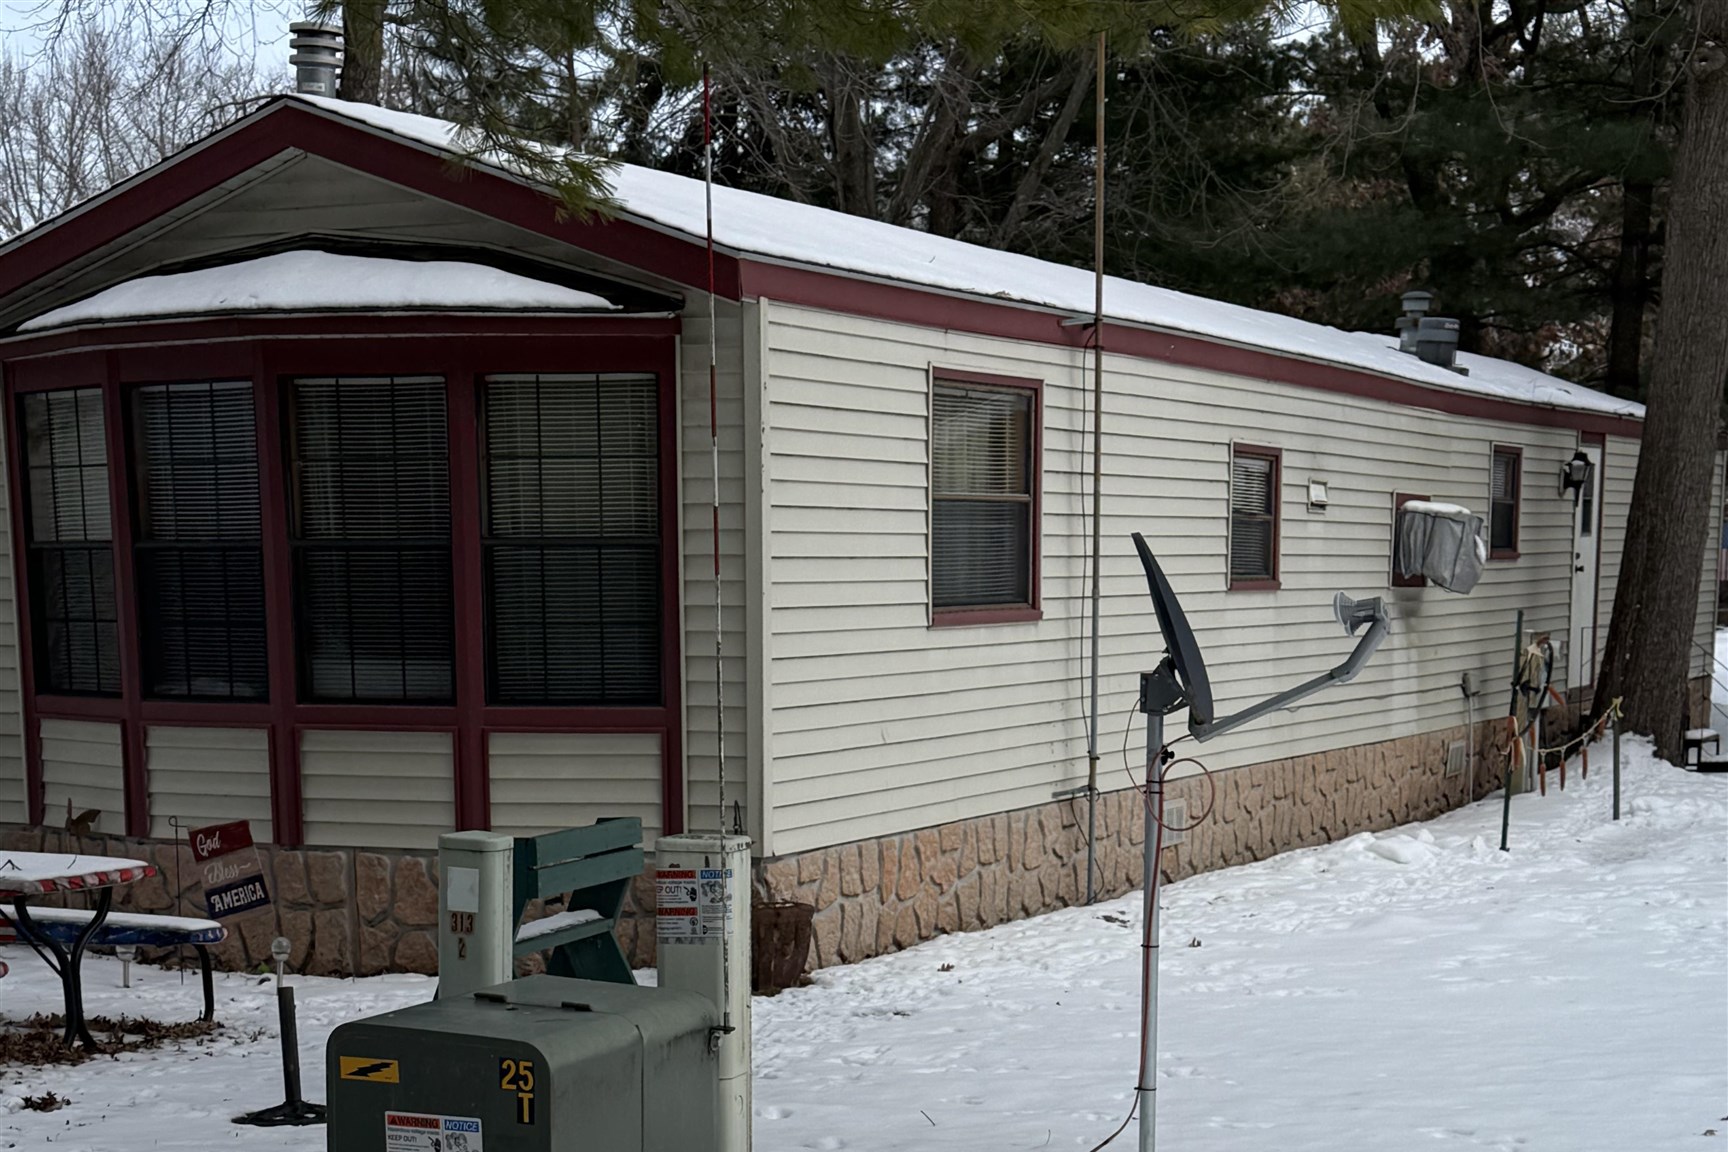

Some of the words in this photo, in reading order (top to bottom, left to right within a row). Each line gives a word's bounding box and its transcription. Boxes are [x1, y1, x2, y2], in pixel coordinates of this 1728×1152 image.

[196, 831, 221, 857] God
[204, 862, 251, 884] Bless
[210, 882, 264, 912] AMERICA
[665, 886, 682, 894] OUT!
[451, 913, 473, 933] 313
[458, 938, 466, 958] 2
[501, 1059, 535, 1092] 25
[518, 1092, 535, 1124] T
[399, 1115, 440, 1129] WARNING
[445, 1120, 479, 1132] NOTICE
[403, 1135, 417, 1143] OUT!
